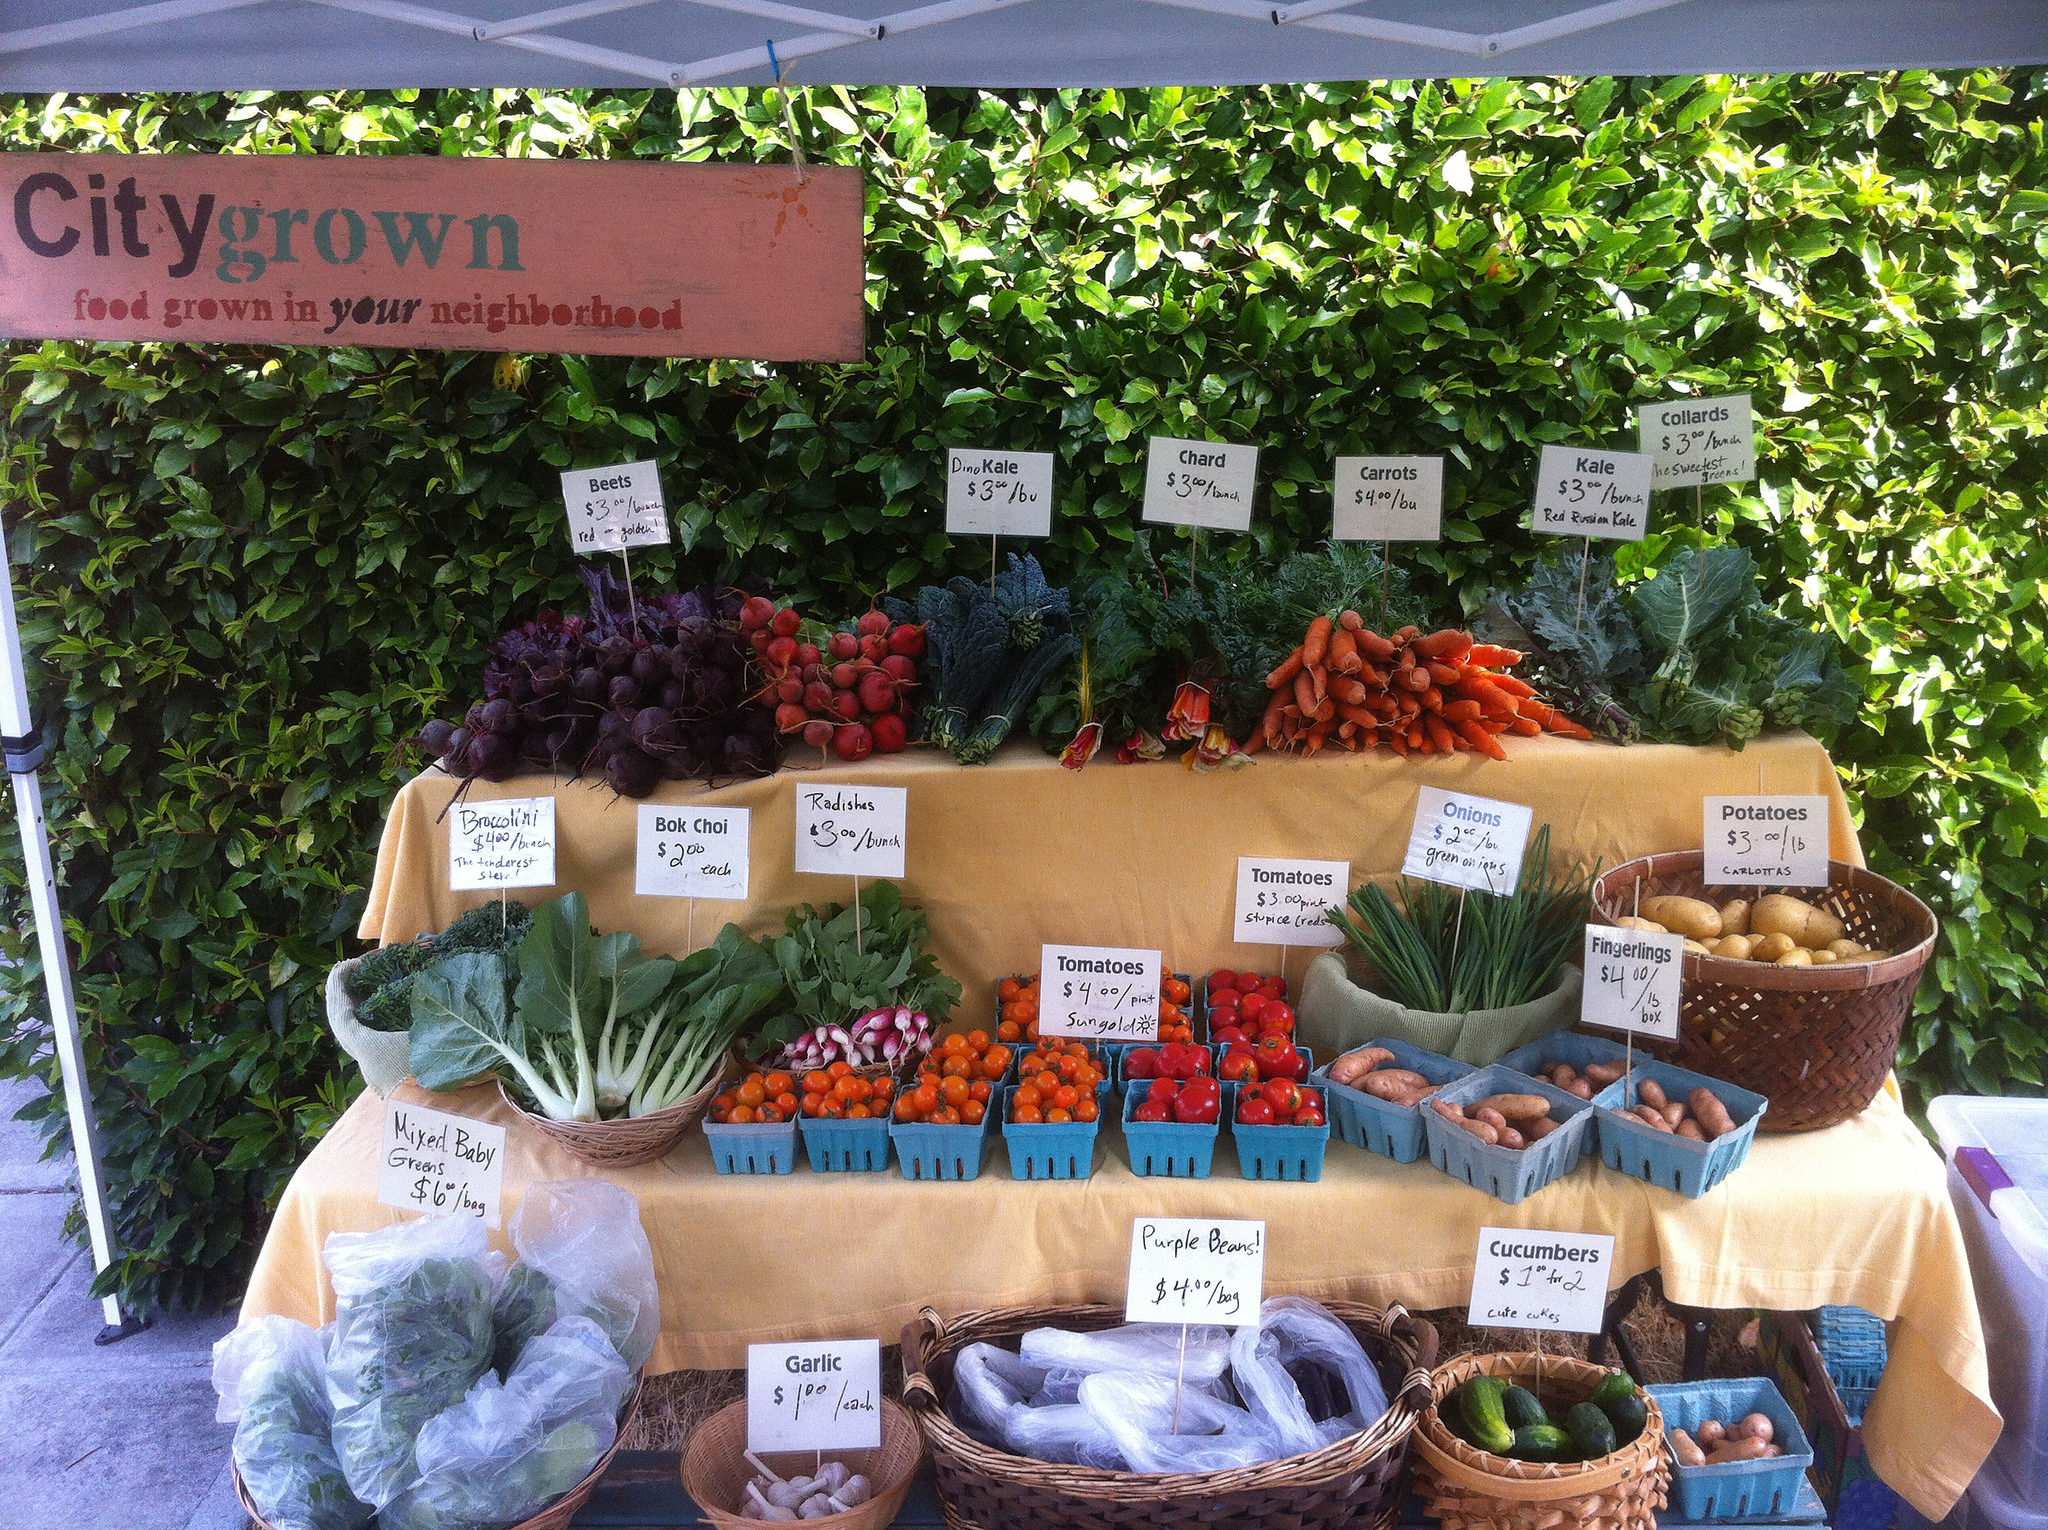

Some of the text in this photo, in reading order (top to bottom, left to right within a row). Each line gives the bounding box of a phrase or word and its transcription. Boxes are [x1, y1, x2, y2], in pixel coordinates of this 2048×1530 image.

[73, 289, 683, 334] food grown in your neighborhood
[1661, 407, 1729, 426] Collards
[952, 457, 1019, 475] Dino Kale
[1179, 450, 1226, 468] Chard
[1576, 457, 1615, 475] Kale
[1360, 466, 1418, 481] Carrots
[589, 474, 632, 493] Beets
[1543, 508, 1637, 527] Red Russian Kale
[579, 527, 596, 543] red
[804, 791, 876, 812] Radishes
[459, 807, 540, 836] Broccolini
[1443, 802, 1502, 827] Onions
[1722, 805, 1808, 821] Potatoes
[655, 816, 729, 835] Bok Choi
[454, 855, 540, 869] The tenderest
[701, 862, 732, 876] each
[1425, 847, 1507, 876] green onions
[1251, 868, 1333, 886] Tomatoes
[1591, 936, 1672, 964] Fingerlings
[1057, 955, 1145, 976] Tomatoes
[1641, 1006, 1662, 1024] box
[394, 1110, 497, 1172] Mixed Baby
[388, 1147, 446, 1176] Greens
[1142, 1224, 1260, 1258] Purple Beans!
[1490, 1240, 1600, 1264] Cucumbers
[1562, 1270, 1586, 1292] 2
[785, 1353, 842, 1374] Garlic
